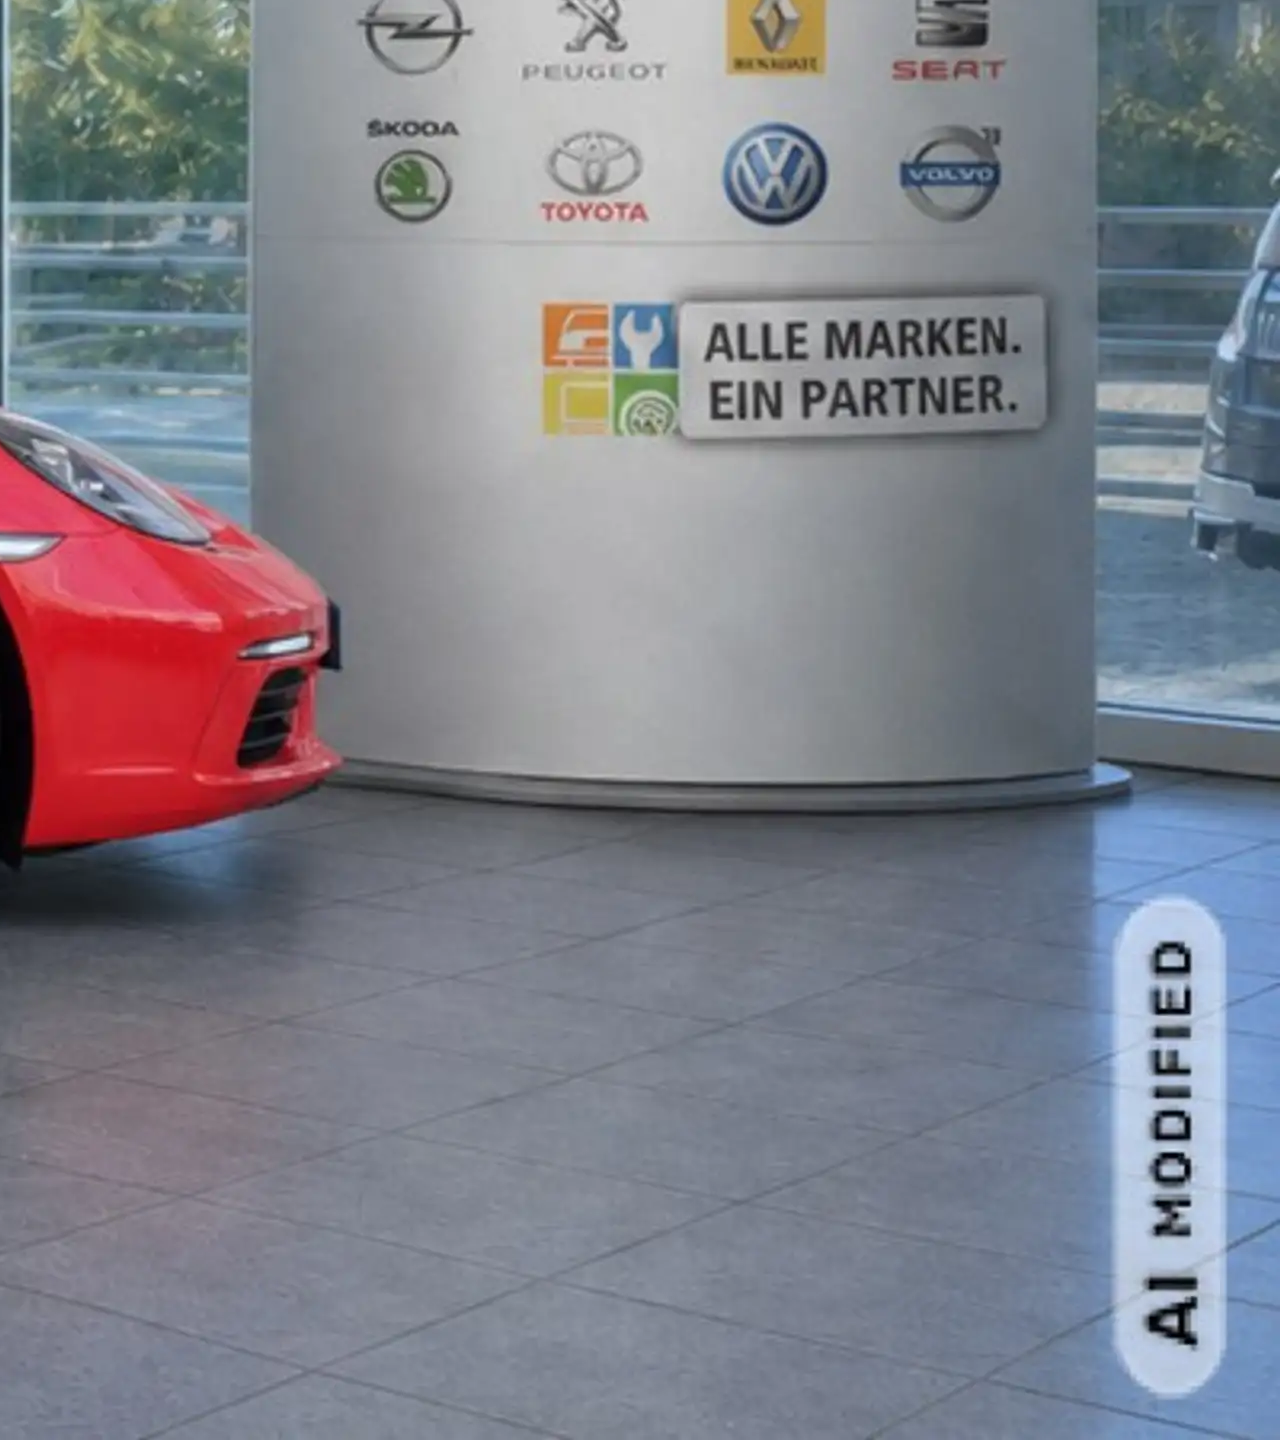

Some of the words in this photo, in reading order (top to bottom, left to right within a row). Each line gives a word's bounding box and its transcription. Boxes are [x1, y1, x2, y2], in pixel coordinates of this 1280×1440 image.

[522, 63, 668, 82] PEUGEOT
[891, 59, 1008, 81] SEAT
[908, 166, 995, 182] VOLVO
[541, 201, 649, 222] TOYOTA
[704, 321, 809, 362] ALLE
[824, 315, 1022, 361] MARKEN.
[708, 379, 783, 421] EIN
[800, 374, 1018, 419] PARTNER.
